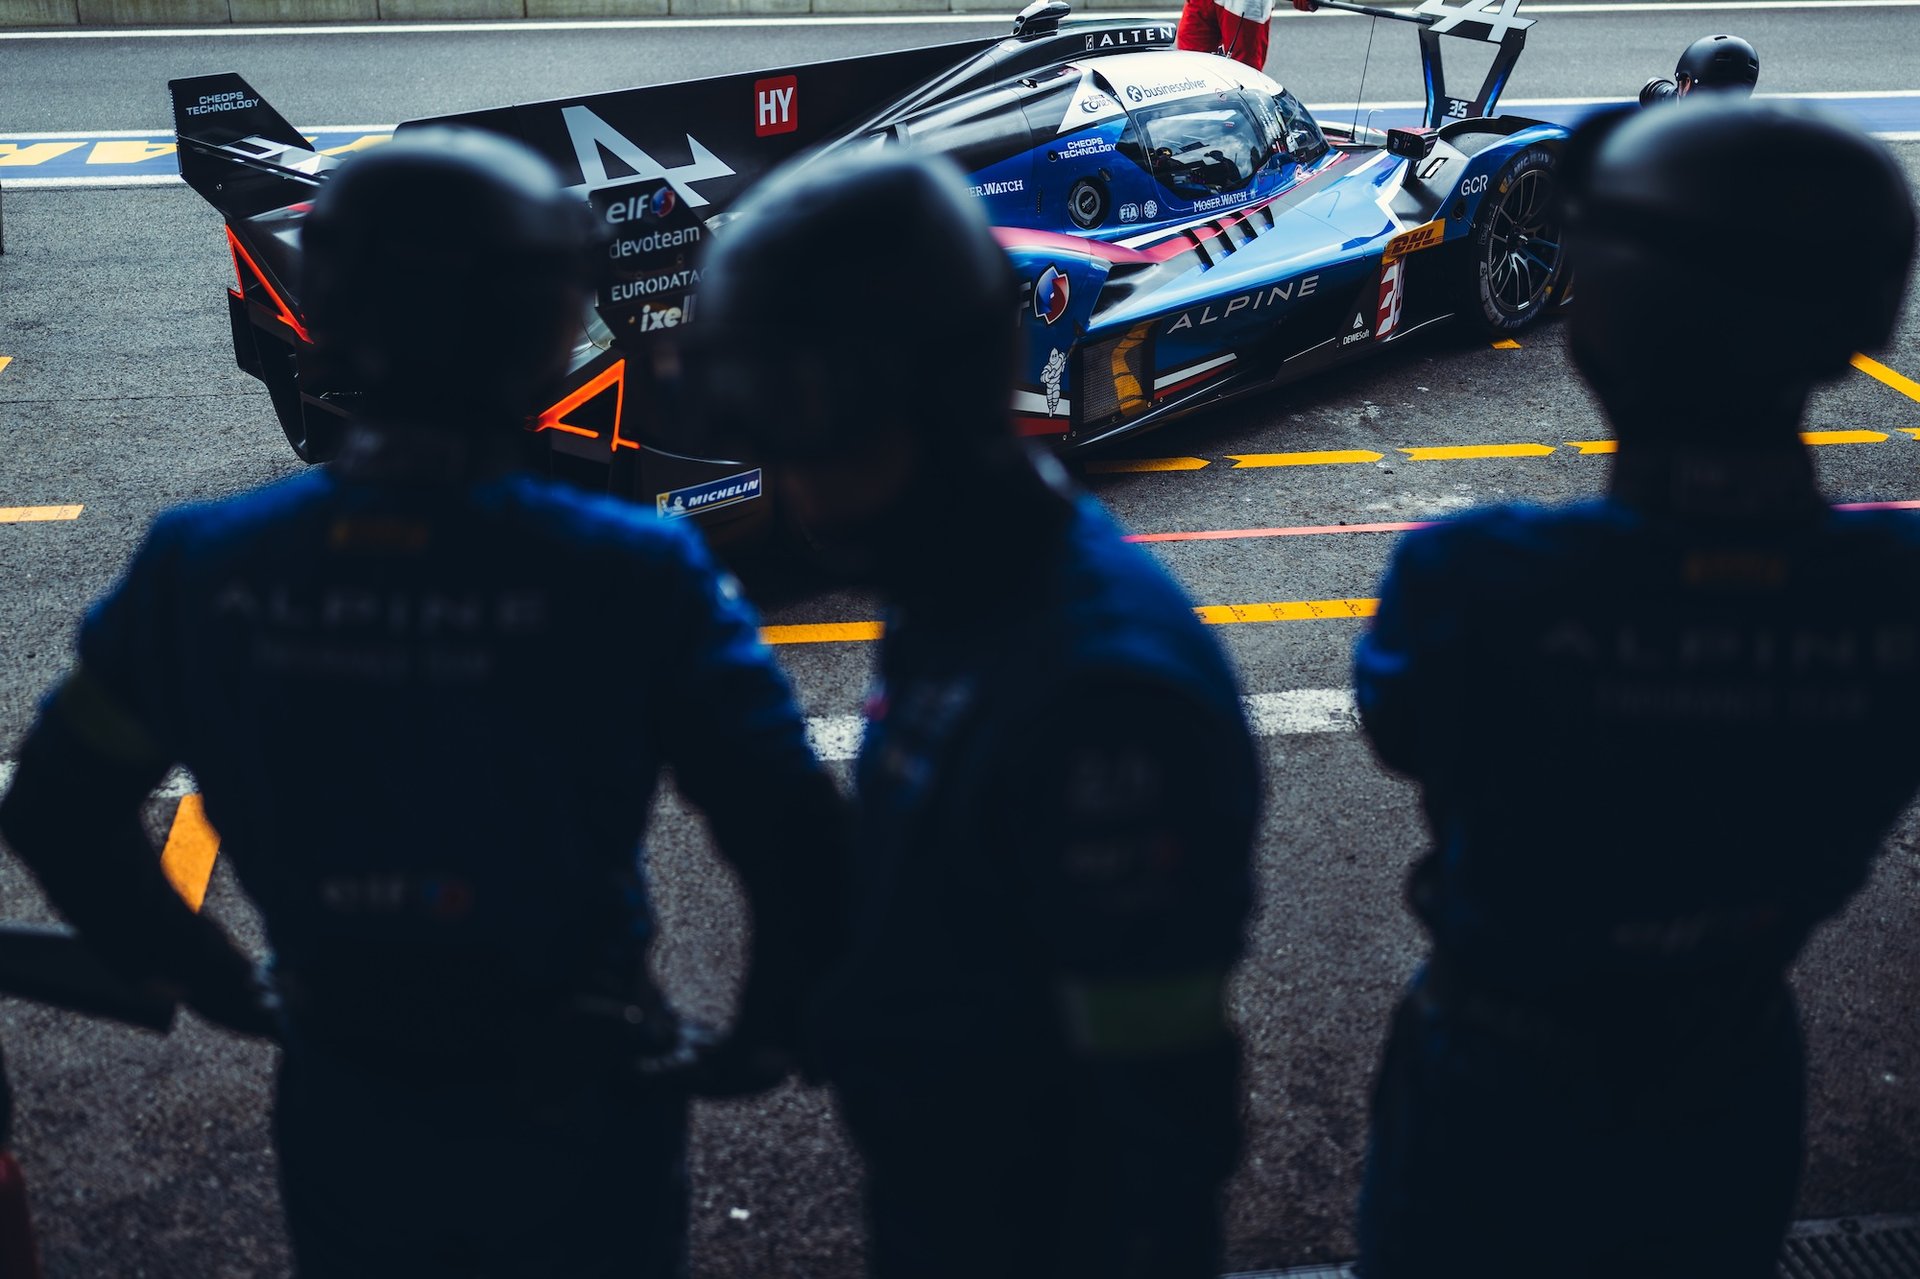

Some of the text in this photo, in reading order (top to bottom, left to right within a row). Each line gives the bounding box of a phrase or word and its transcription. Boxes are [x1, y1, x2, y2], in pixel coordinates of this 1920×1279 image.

[1099, 26, 1174, 47] ALTEN
[199, 91, 244, 105] CHEOPS
[1140, 77, 1207, 98] businessolver
[186, 98, 260, 116] TECHNOLOGY
[759, 87, 794, 126] HY
[1447, 99, 1469, 119] 35
[1057, 143, 1118, 160] TECHNOLOGY
[1067, 137, 1104, 150] CHEOPS
[1460, 174, 1489, 196] GCR
[605, 194, 650, 224] elf
[609, 226, 700, 259] devoteam
[1391, 228, 1436, 255] DHL
[640, 294, 697, 332] ixell
[1166, 274, 1320, 335] ALPINE
[688, 479, 759, 507] MICHELIN
